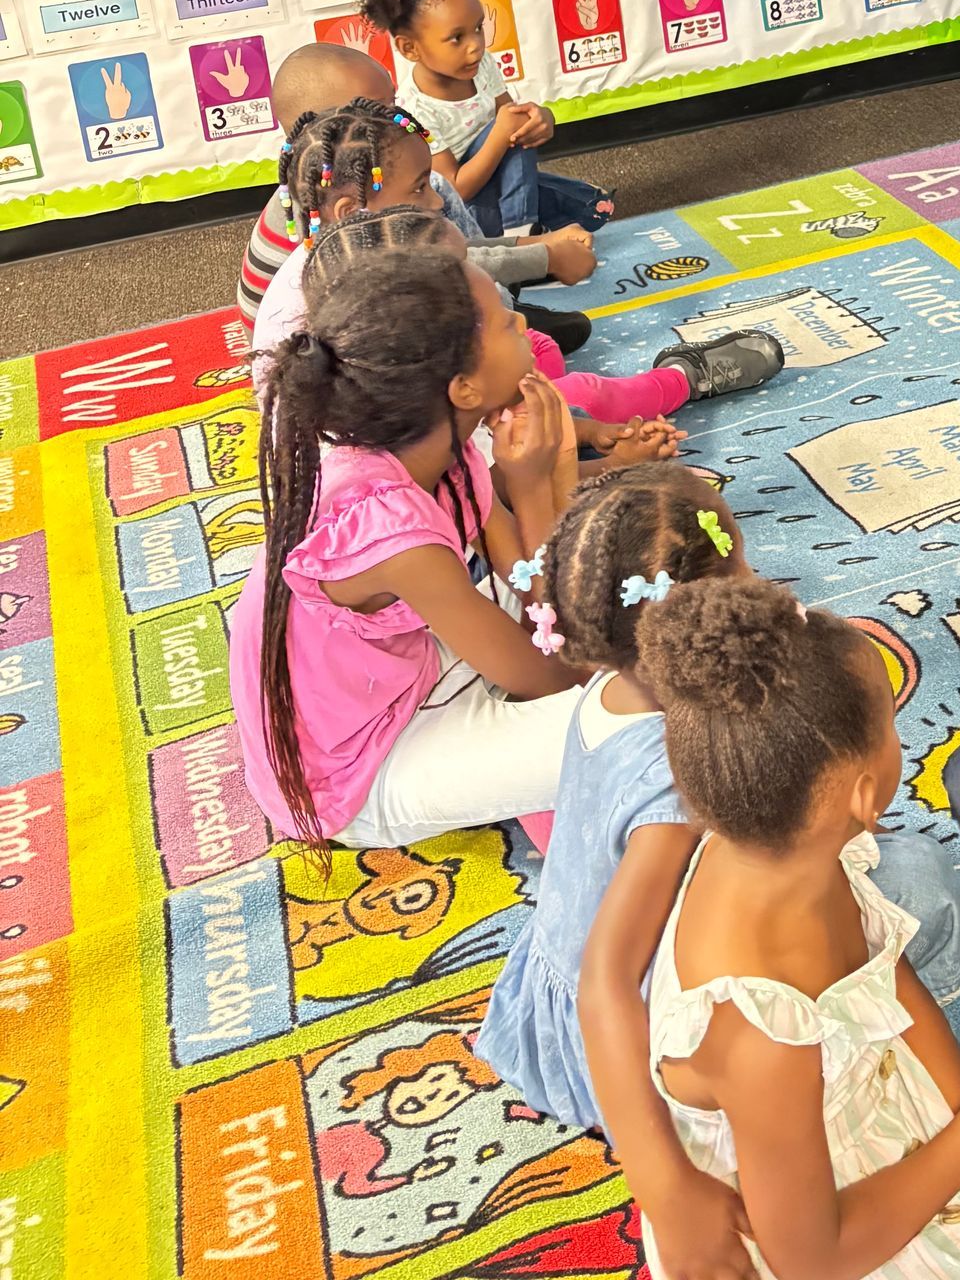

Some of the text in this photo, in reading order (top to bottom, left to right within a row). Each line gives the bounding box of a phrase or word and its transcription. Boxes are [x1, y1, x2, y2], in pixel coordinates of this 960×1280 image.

[58, 1, 121, 24] Twelve
[671, 22, 682, 43] 7
[95, 126, 113, 151] 2
[833, 183, 877, 208] zebra
[634, 226, 682, 252] yarn
[787, 301, 855, 352] December
[120, 441, 178, 499] Sunday
[837, 462, 883, 494] May
[881, 447, 947, 480] April
[131, 518, 196, 593] Monday
[154, 615, 224, 711] Tuesday
[181, 730, 249, 873] Wednesday
[185, 855, 276, 1041] Thursday
[205, 1104, 304, 1261] Friday
